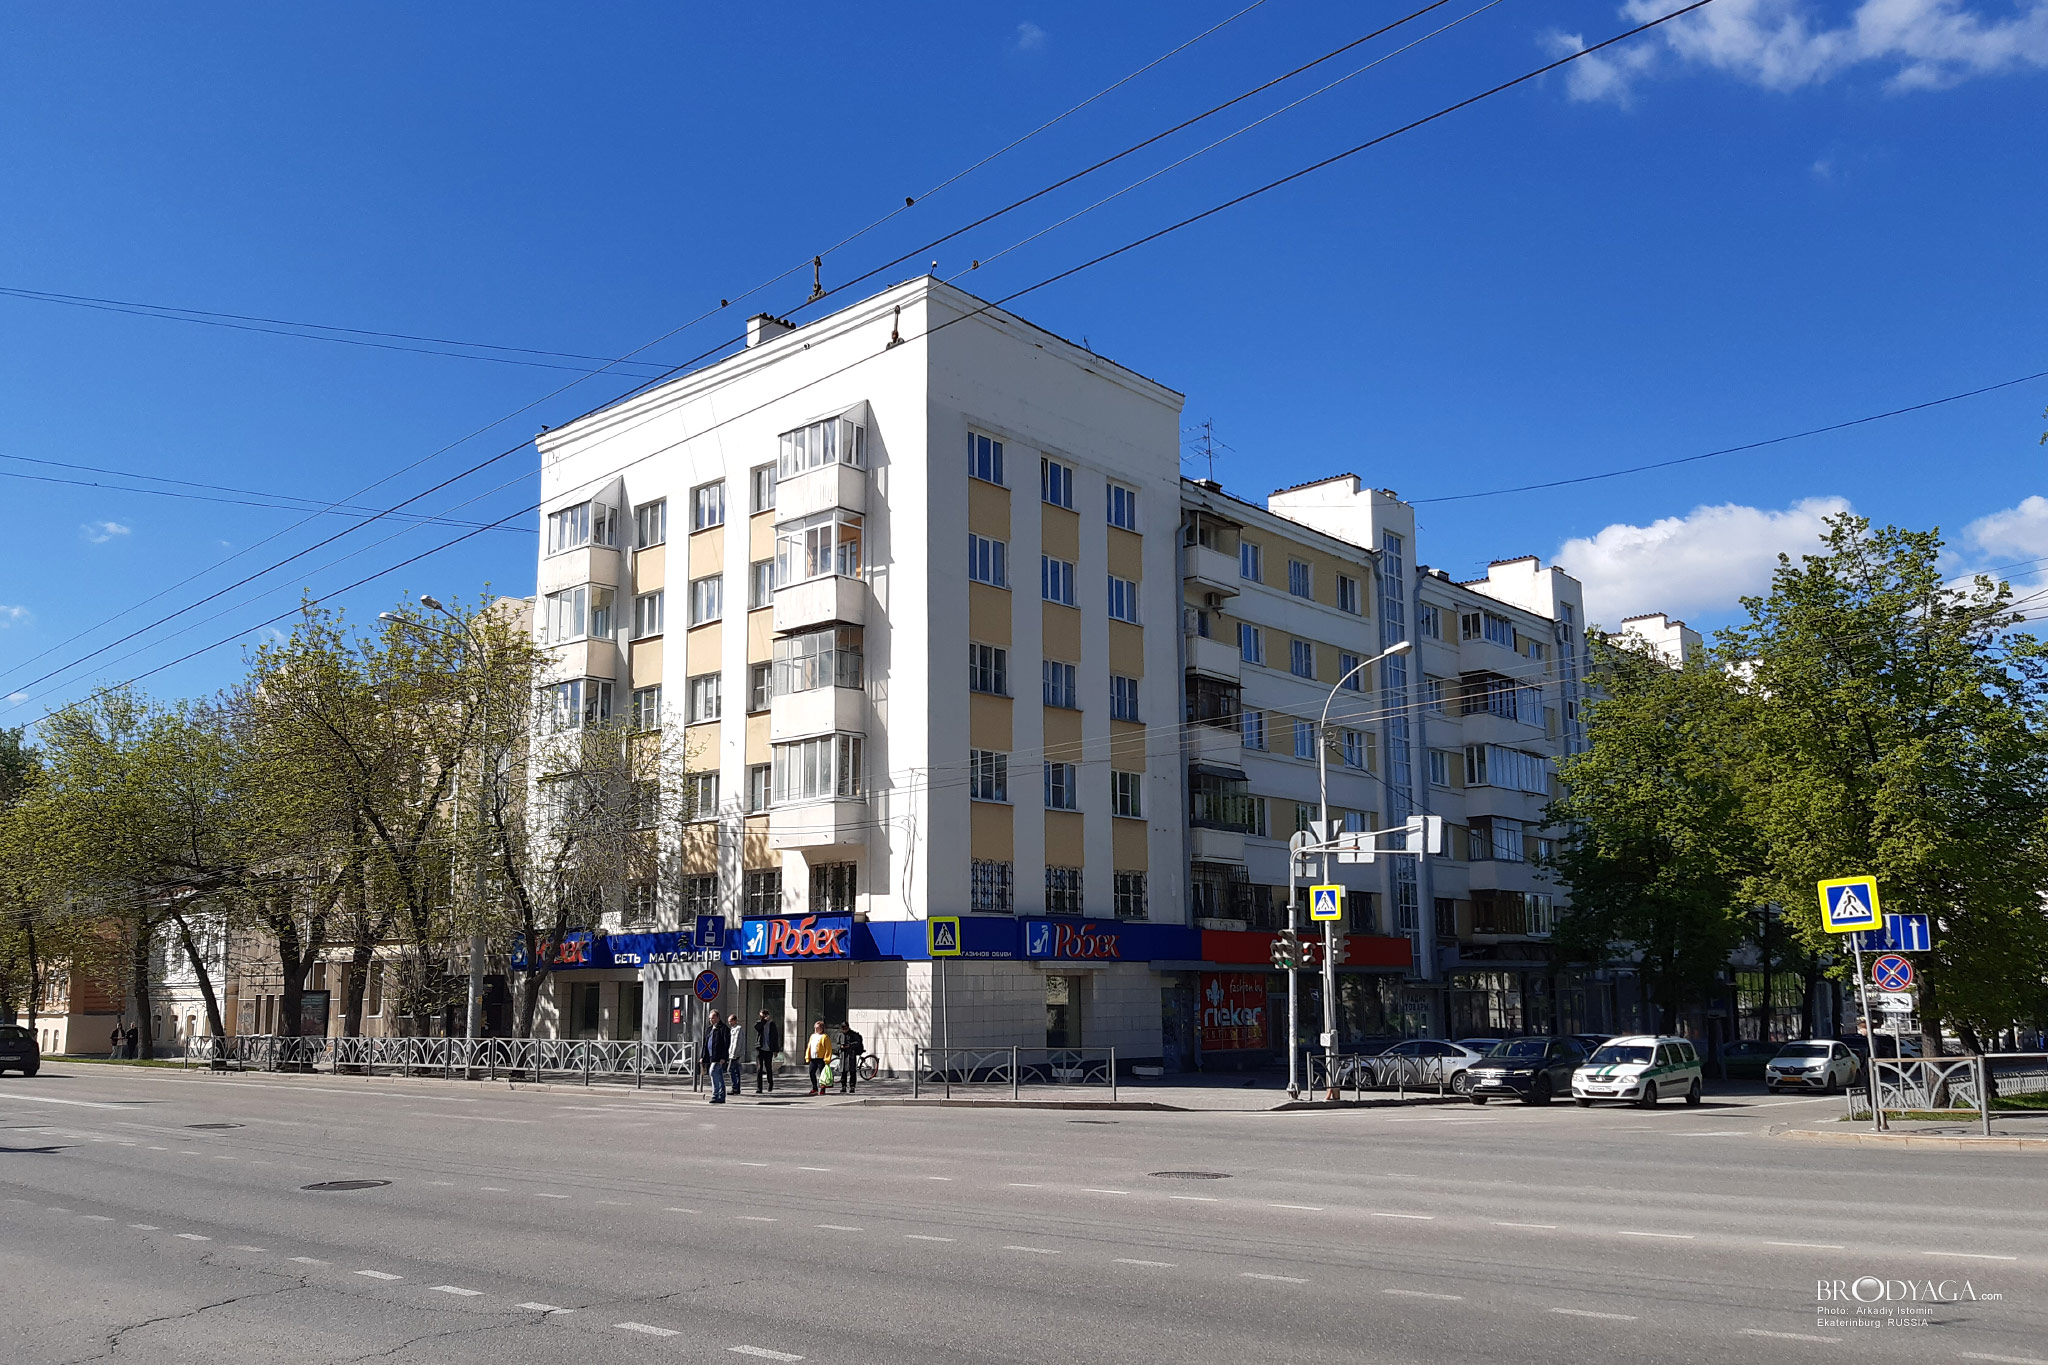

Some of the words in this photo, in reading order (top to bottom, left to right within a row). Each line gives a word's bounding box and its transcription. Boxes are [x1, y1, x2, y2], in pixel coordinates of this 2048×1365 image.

[769, 914, 846, 956] Робек
[1054, 923, 1121, 958] Робек
[614, 953, 641, 964] СЕТЬ
[649, 950, 721, 963] МАГАЗИНОВ
[1204, 1000, 1262, 1027] rieker
